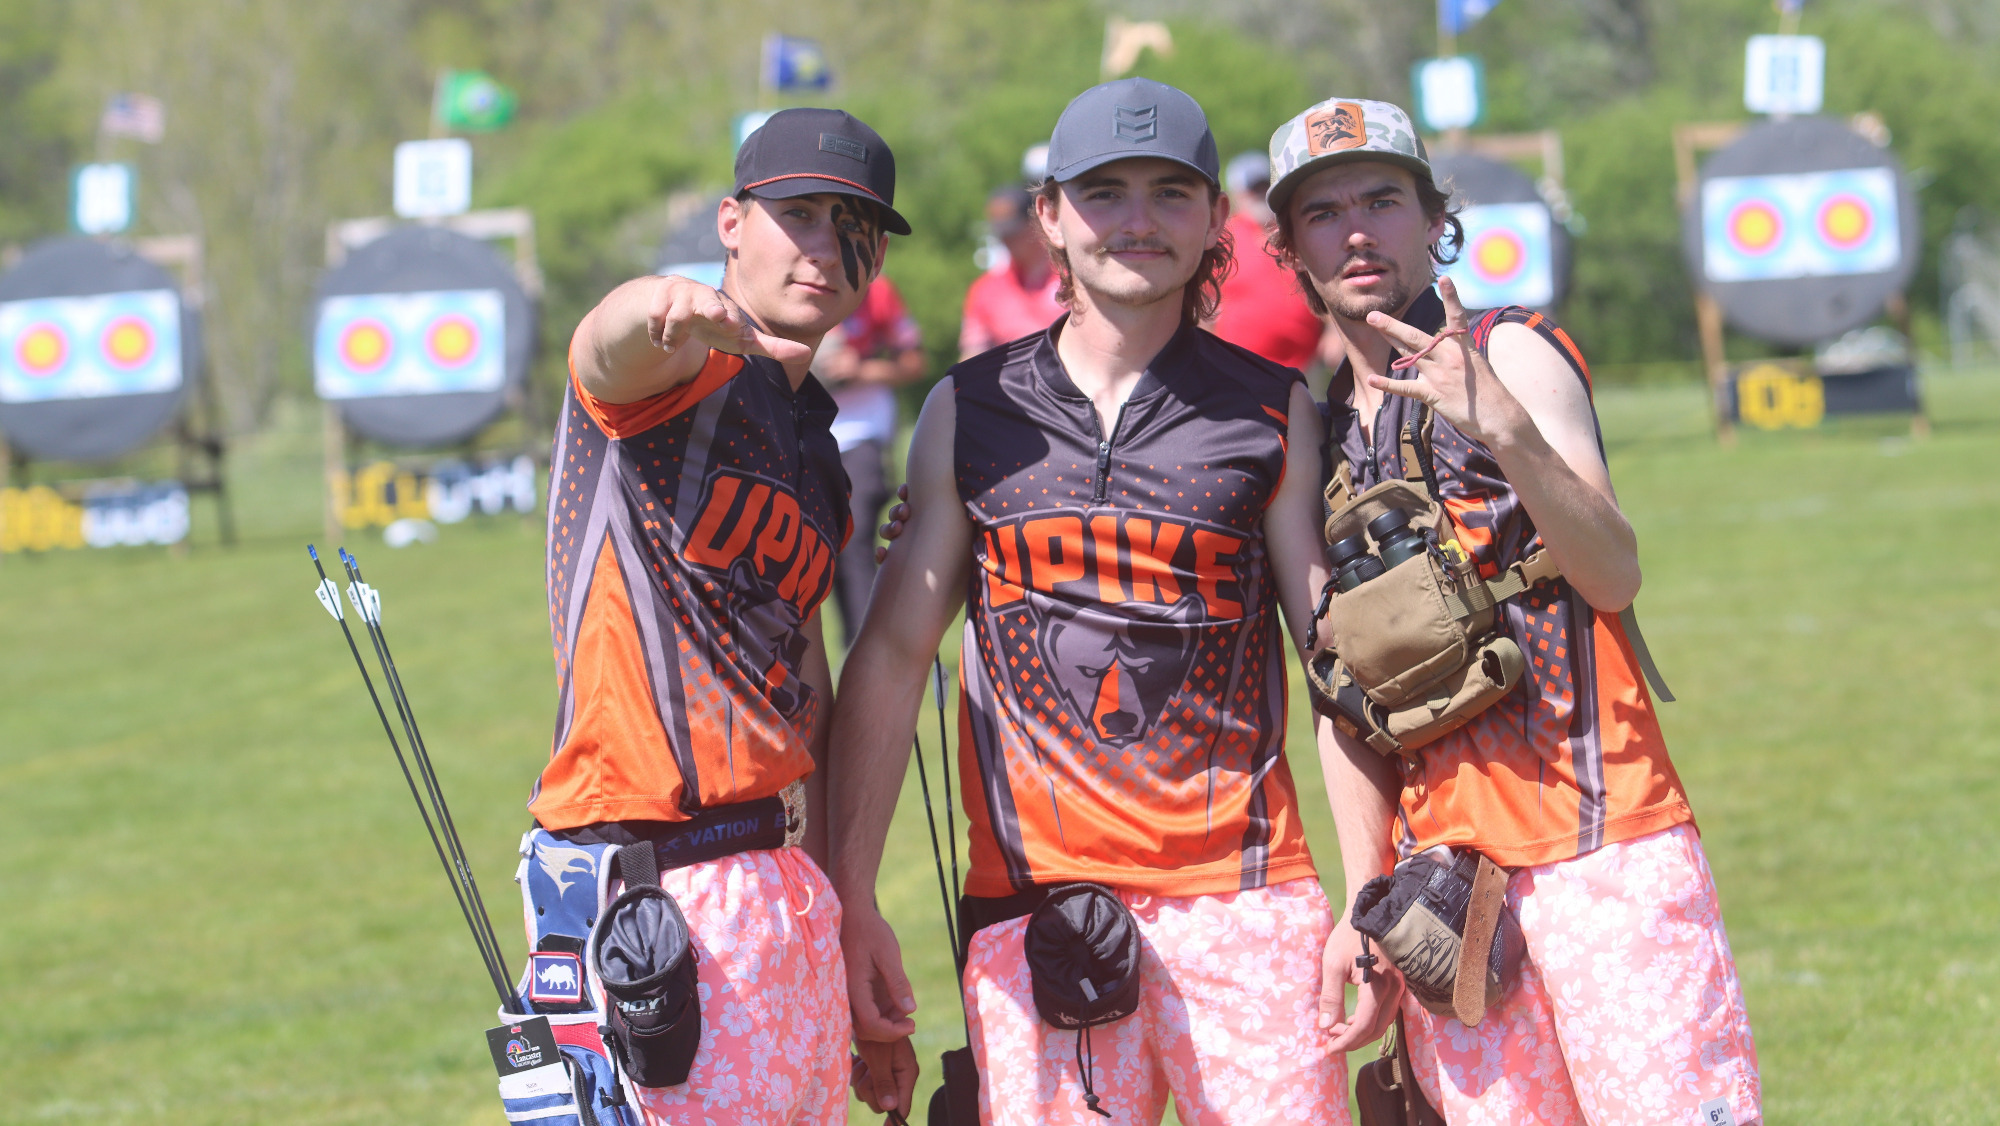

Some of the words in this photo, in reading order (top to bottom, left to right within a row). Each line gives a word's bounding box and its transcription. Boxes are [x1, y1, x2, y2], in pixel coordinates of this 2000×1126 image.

[982, 515, 1245, 620] UPIKE
[658, 817, 760, 854] VATION
[1710, 1107, 1724, 1122] 6"
